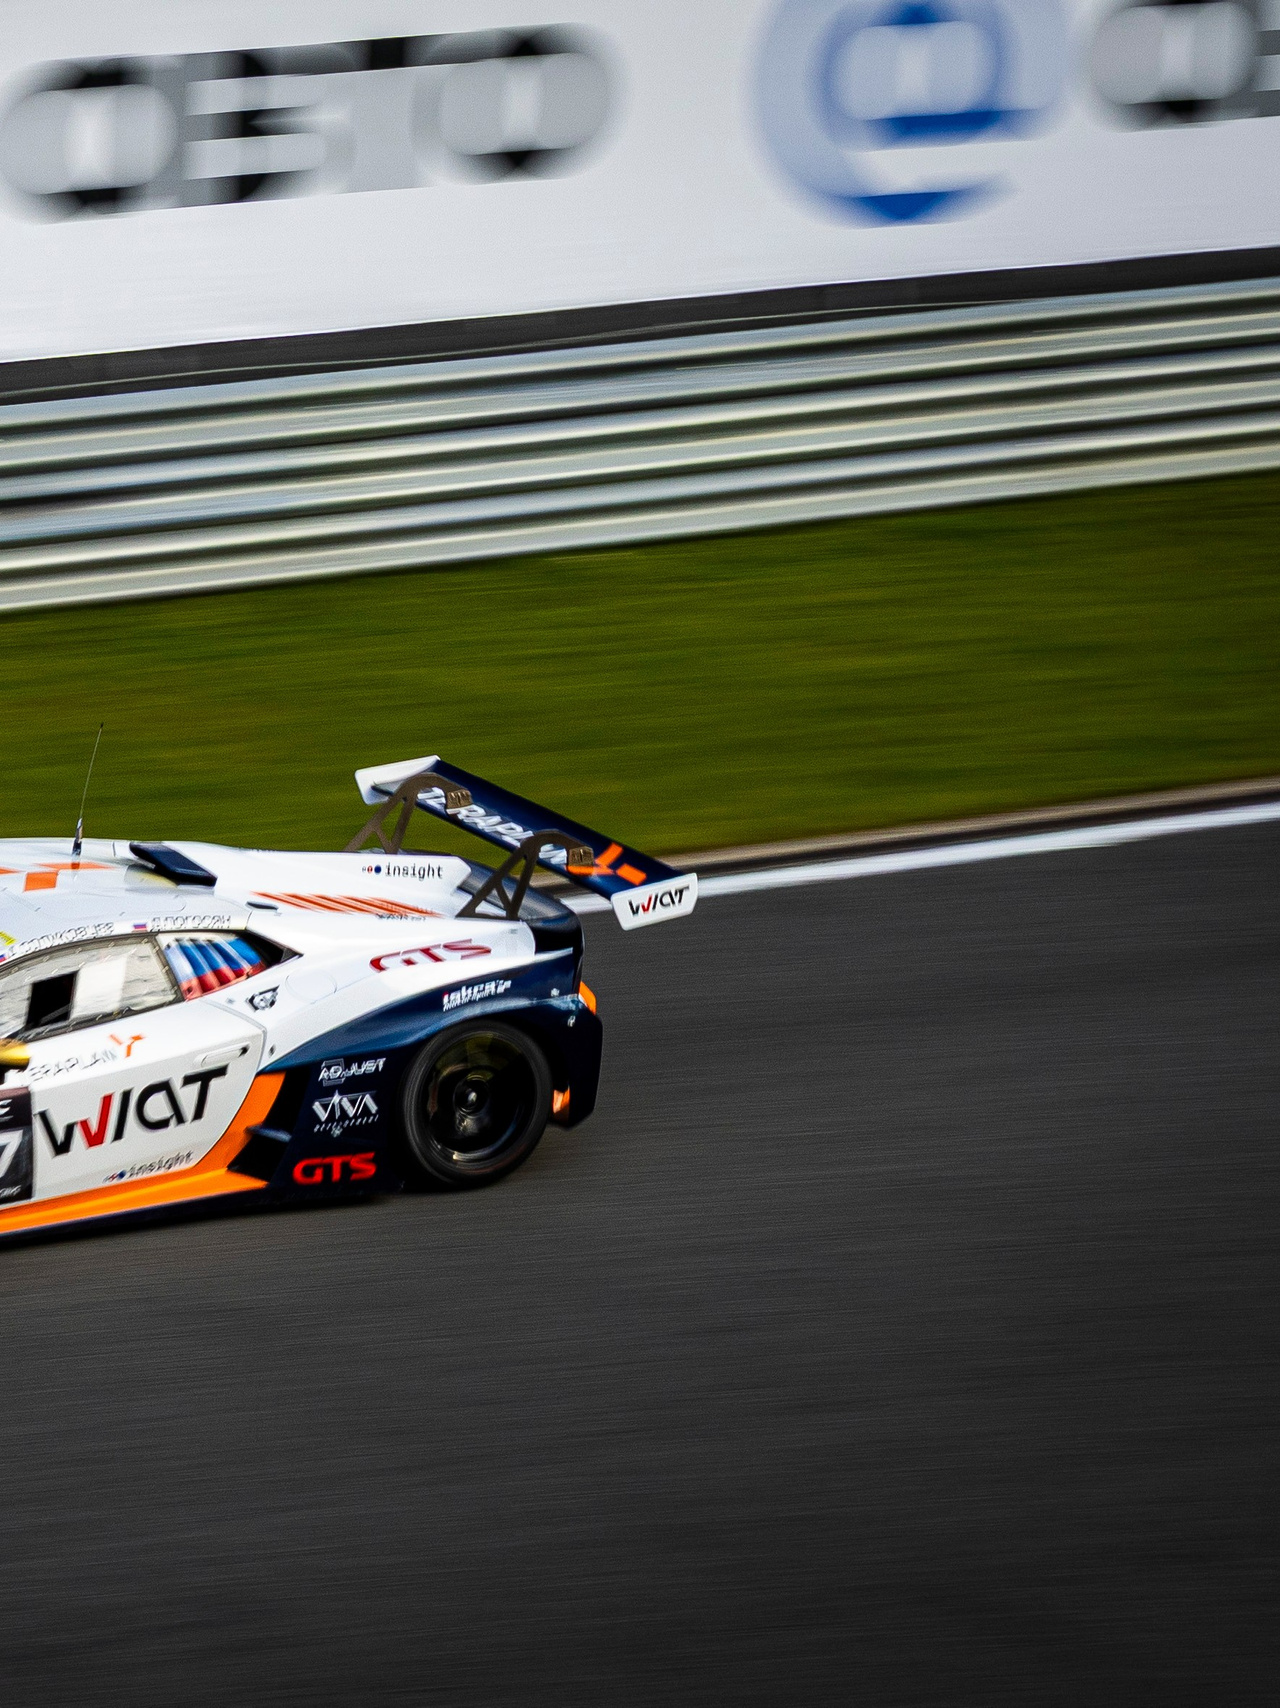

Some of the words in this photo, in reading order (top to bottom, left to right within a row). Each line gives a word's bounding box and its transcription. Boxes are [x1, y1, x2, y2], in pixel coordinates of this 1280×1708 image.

[385, 862, 443, 881] insight
[369, 938, 492, 973] GTS
[126, 1150, 193, 1181] insight
[292, 1152, 377, 1185] GTS
